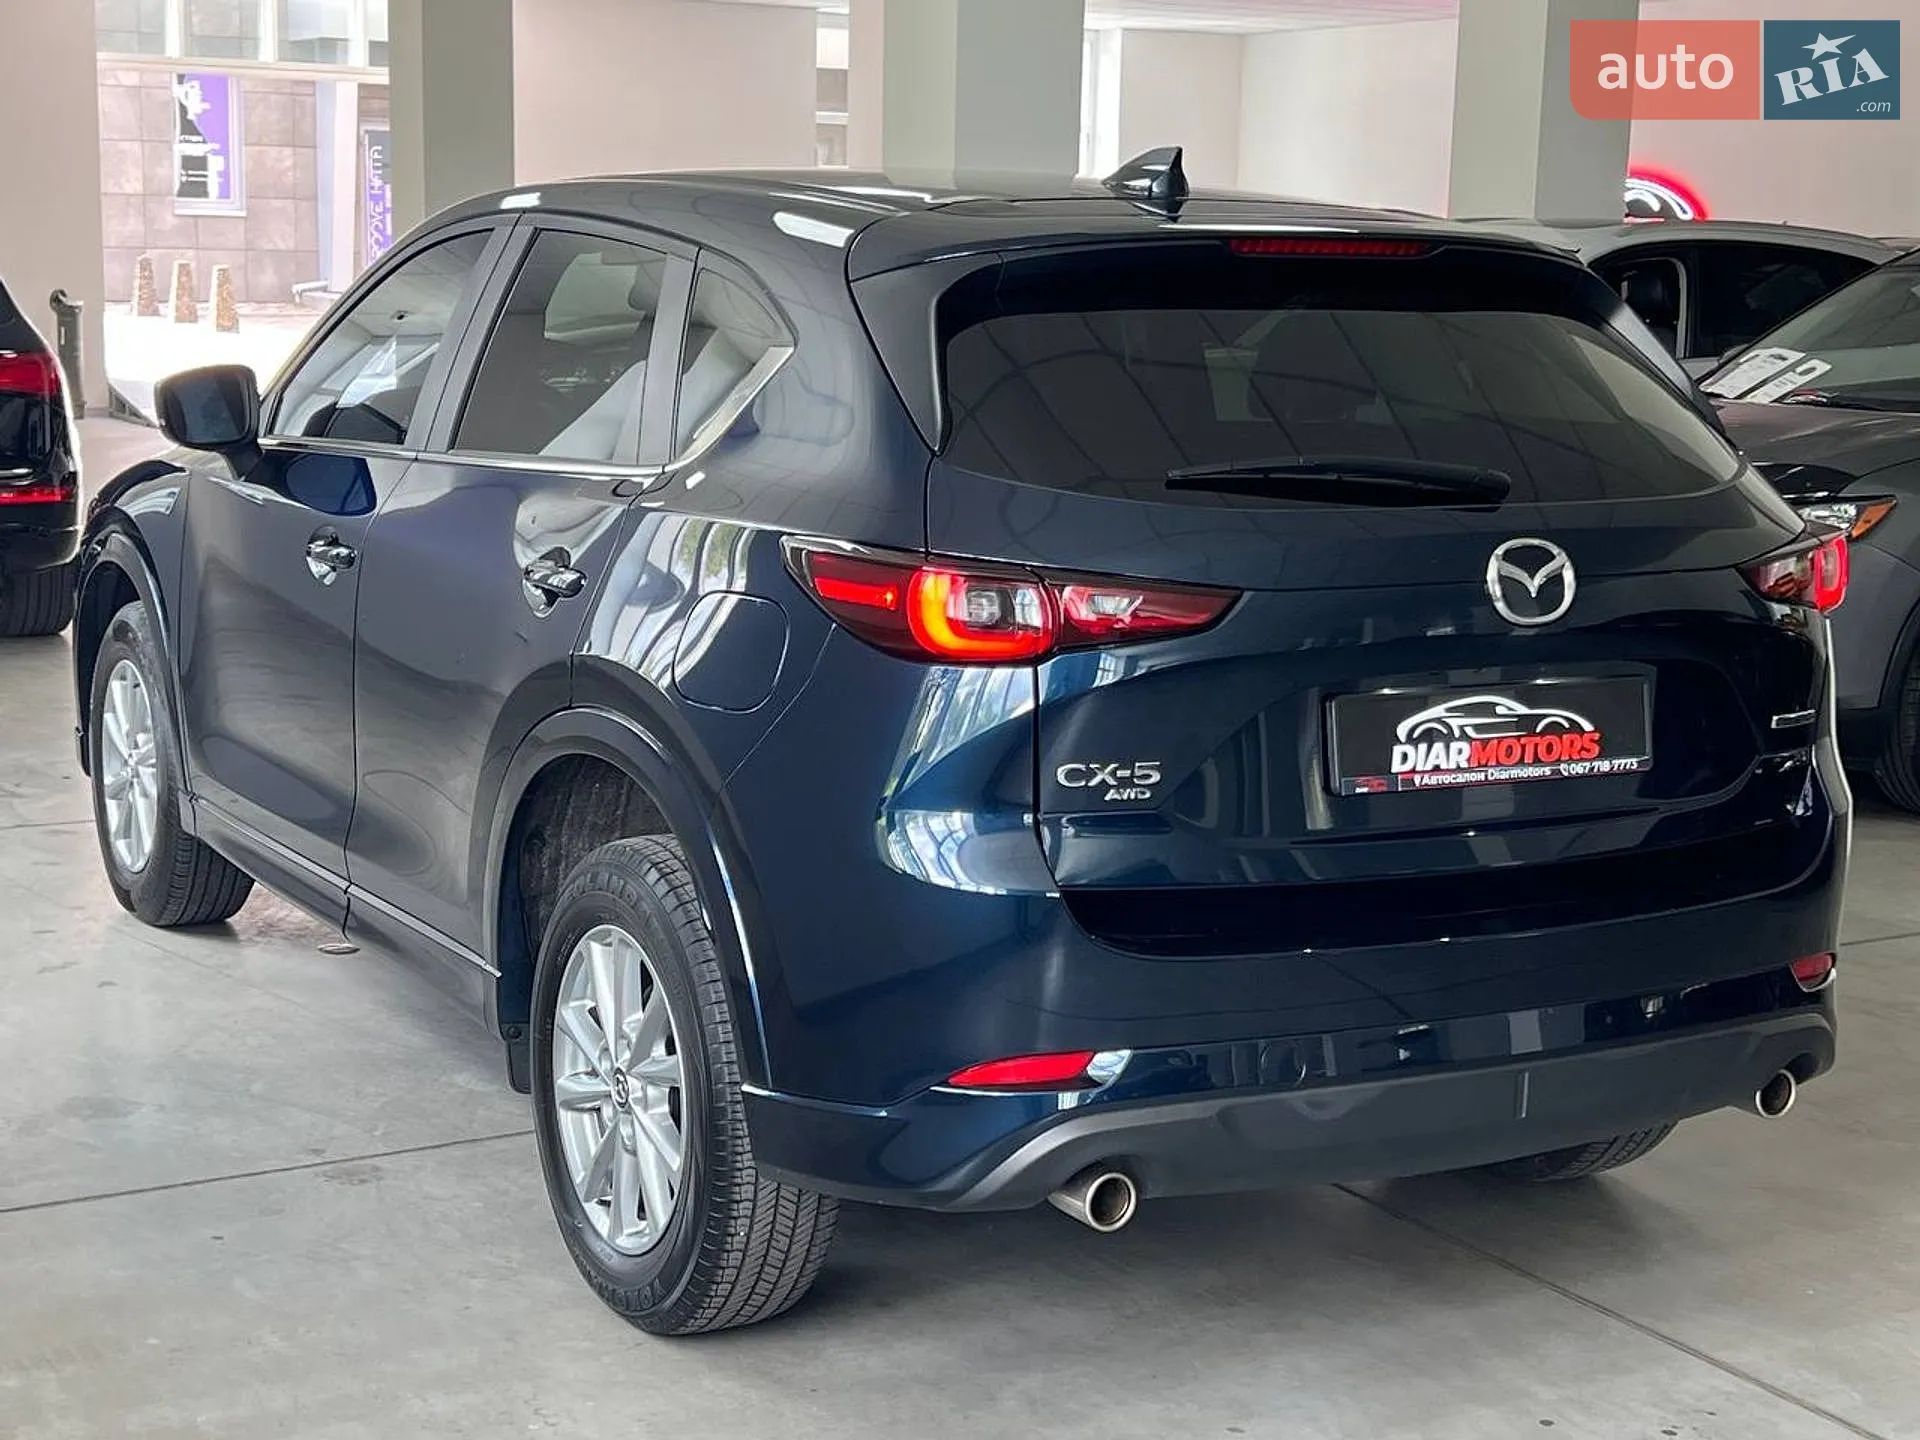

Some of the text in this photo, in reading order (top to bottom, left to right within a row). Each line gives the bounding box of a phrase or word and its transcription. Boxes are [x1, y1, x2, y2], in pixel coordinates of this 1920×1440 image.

[1391, 732, 1600, 774] DIARMOTORS
[1056, 762, 1161, 788] CX-5
[1422, 771, 1485, 786] Автосалон
[1487, 765, 1552, 781] Diarmotors
[1103, 787, 1152, 801] AWD
